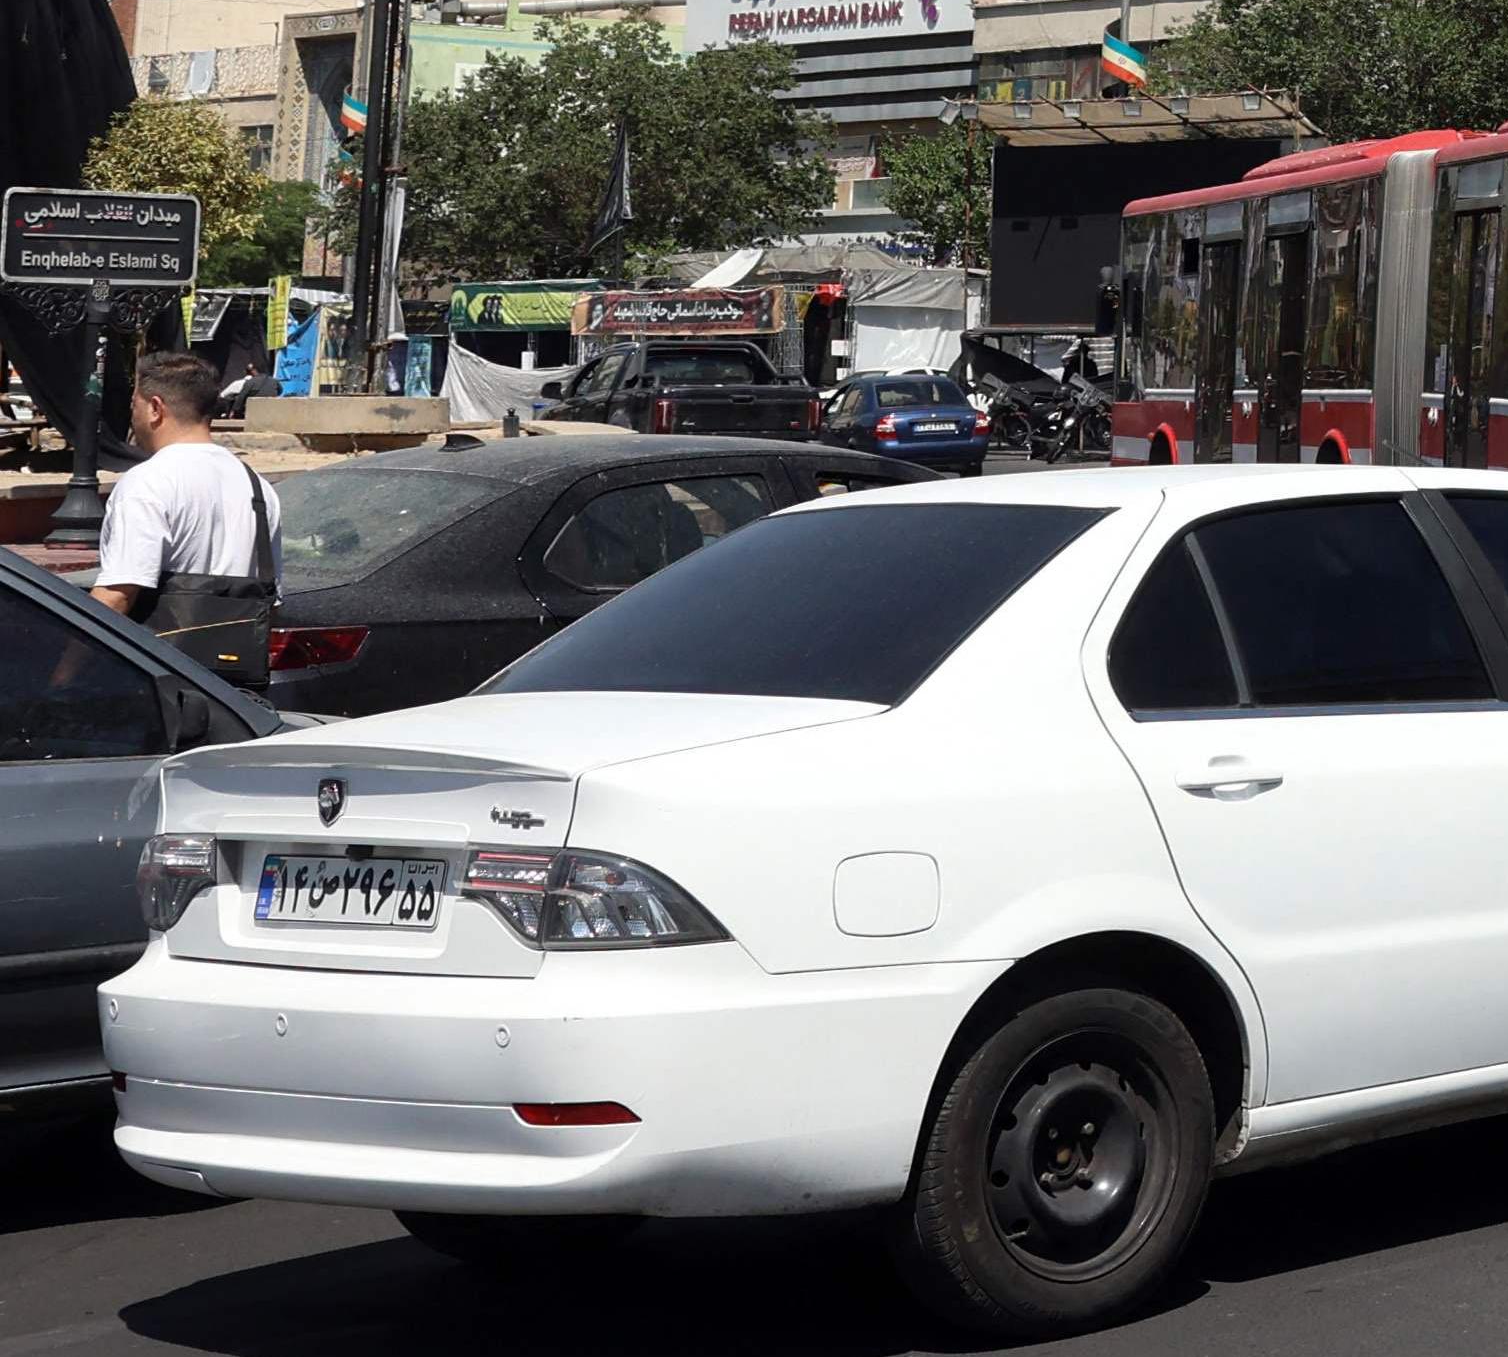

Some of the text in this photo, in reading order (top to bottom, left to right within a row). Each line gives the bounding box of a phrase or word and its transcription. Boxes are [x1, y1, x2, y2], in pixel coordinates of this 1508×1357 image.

[860, 0, 903, 23] BANK
[24, 201, 181, 228] میدان انقلاب اسلامی
[21, 250, 180, 273] Enqhelab-e Eslami Sq
[407, 863, 439, 875] ایران
